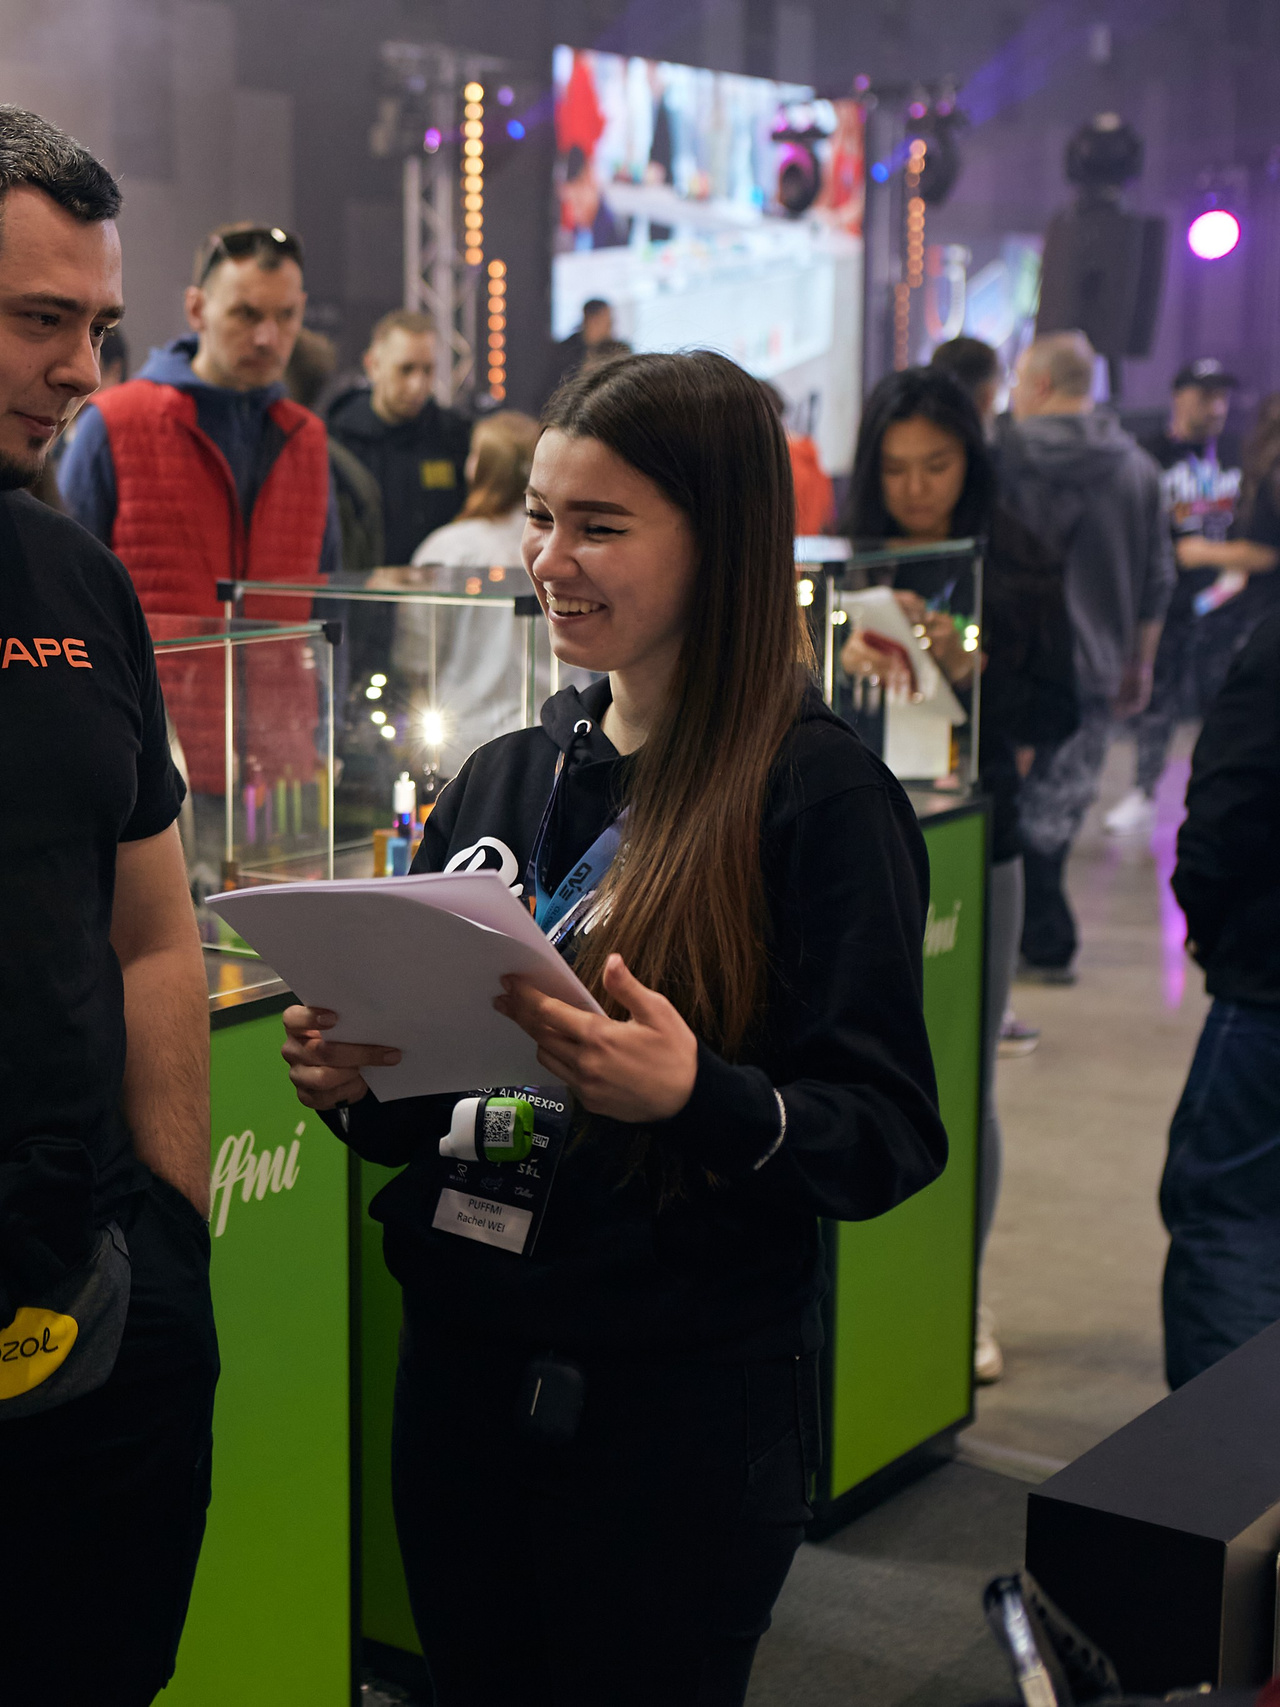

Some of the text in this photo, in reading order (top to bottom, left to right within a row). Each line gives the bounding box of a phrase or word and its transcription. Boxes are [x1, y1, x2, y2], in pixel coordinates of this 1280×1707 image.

[208, 1120, 306, 1238] ffmi
[467, 1198, 503, 1216] PUFFMI
[456, 1211, 506, 1233] Rachel WEI
